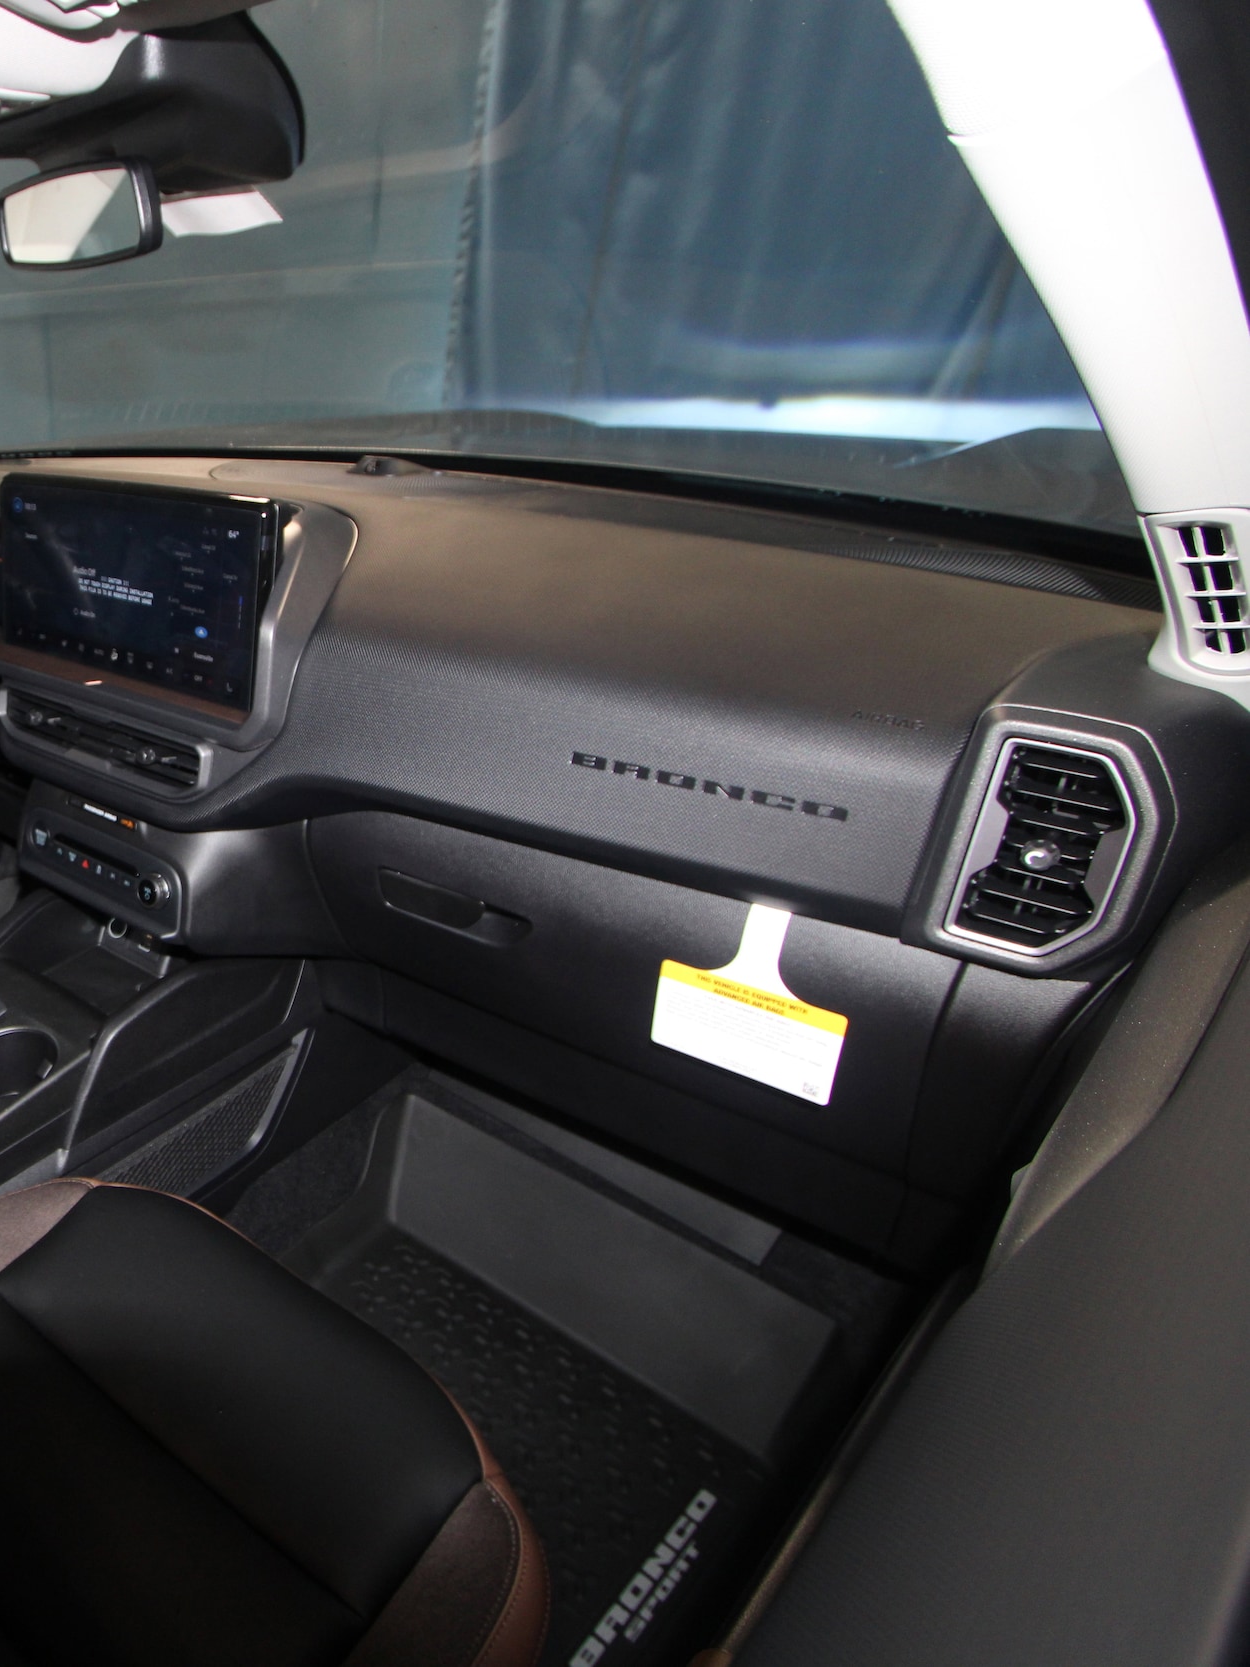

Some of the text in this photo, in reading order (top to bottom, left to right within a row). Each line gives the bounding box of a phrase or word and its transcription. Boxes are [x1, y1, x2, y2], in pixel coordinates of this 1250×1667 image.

[129, 588, 153, 598] INSTALLATION
[851, 709, 926, 731] AIRBAG
[570, 751, 849, 822] BRONCO
[696, 974, 711, 983] THIS
[713, 979, 741, 993] VEHICLE
[752, 992, 787, 1008] EQUIPPED
[789, 1004, 808, 1014] WITH
[713, 988, 750, 1005] ADVANCED
[752, 1000, 763, 1009] AIR
[766, 1005, 785, 1016] BAGS
[569, 1488, 718, 1667] BRONCO
[624, 1540, 700, 1643] SPORT
